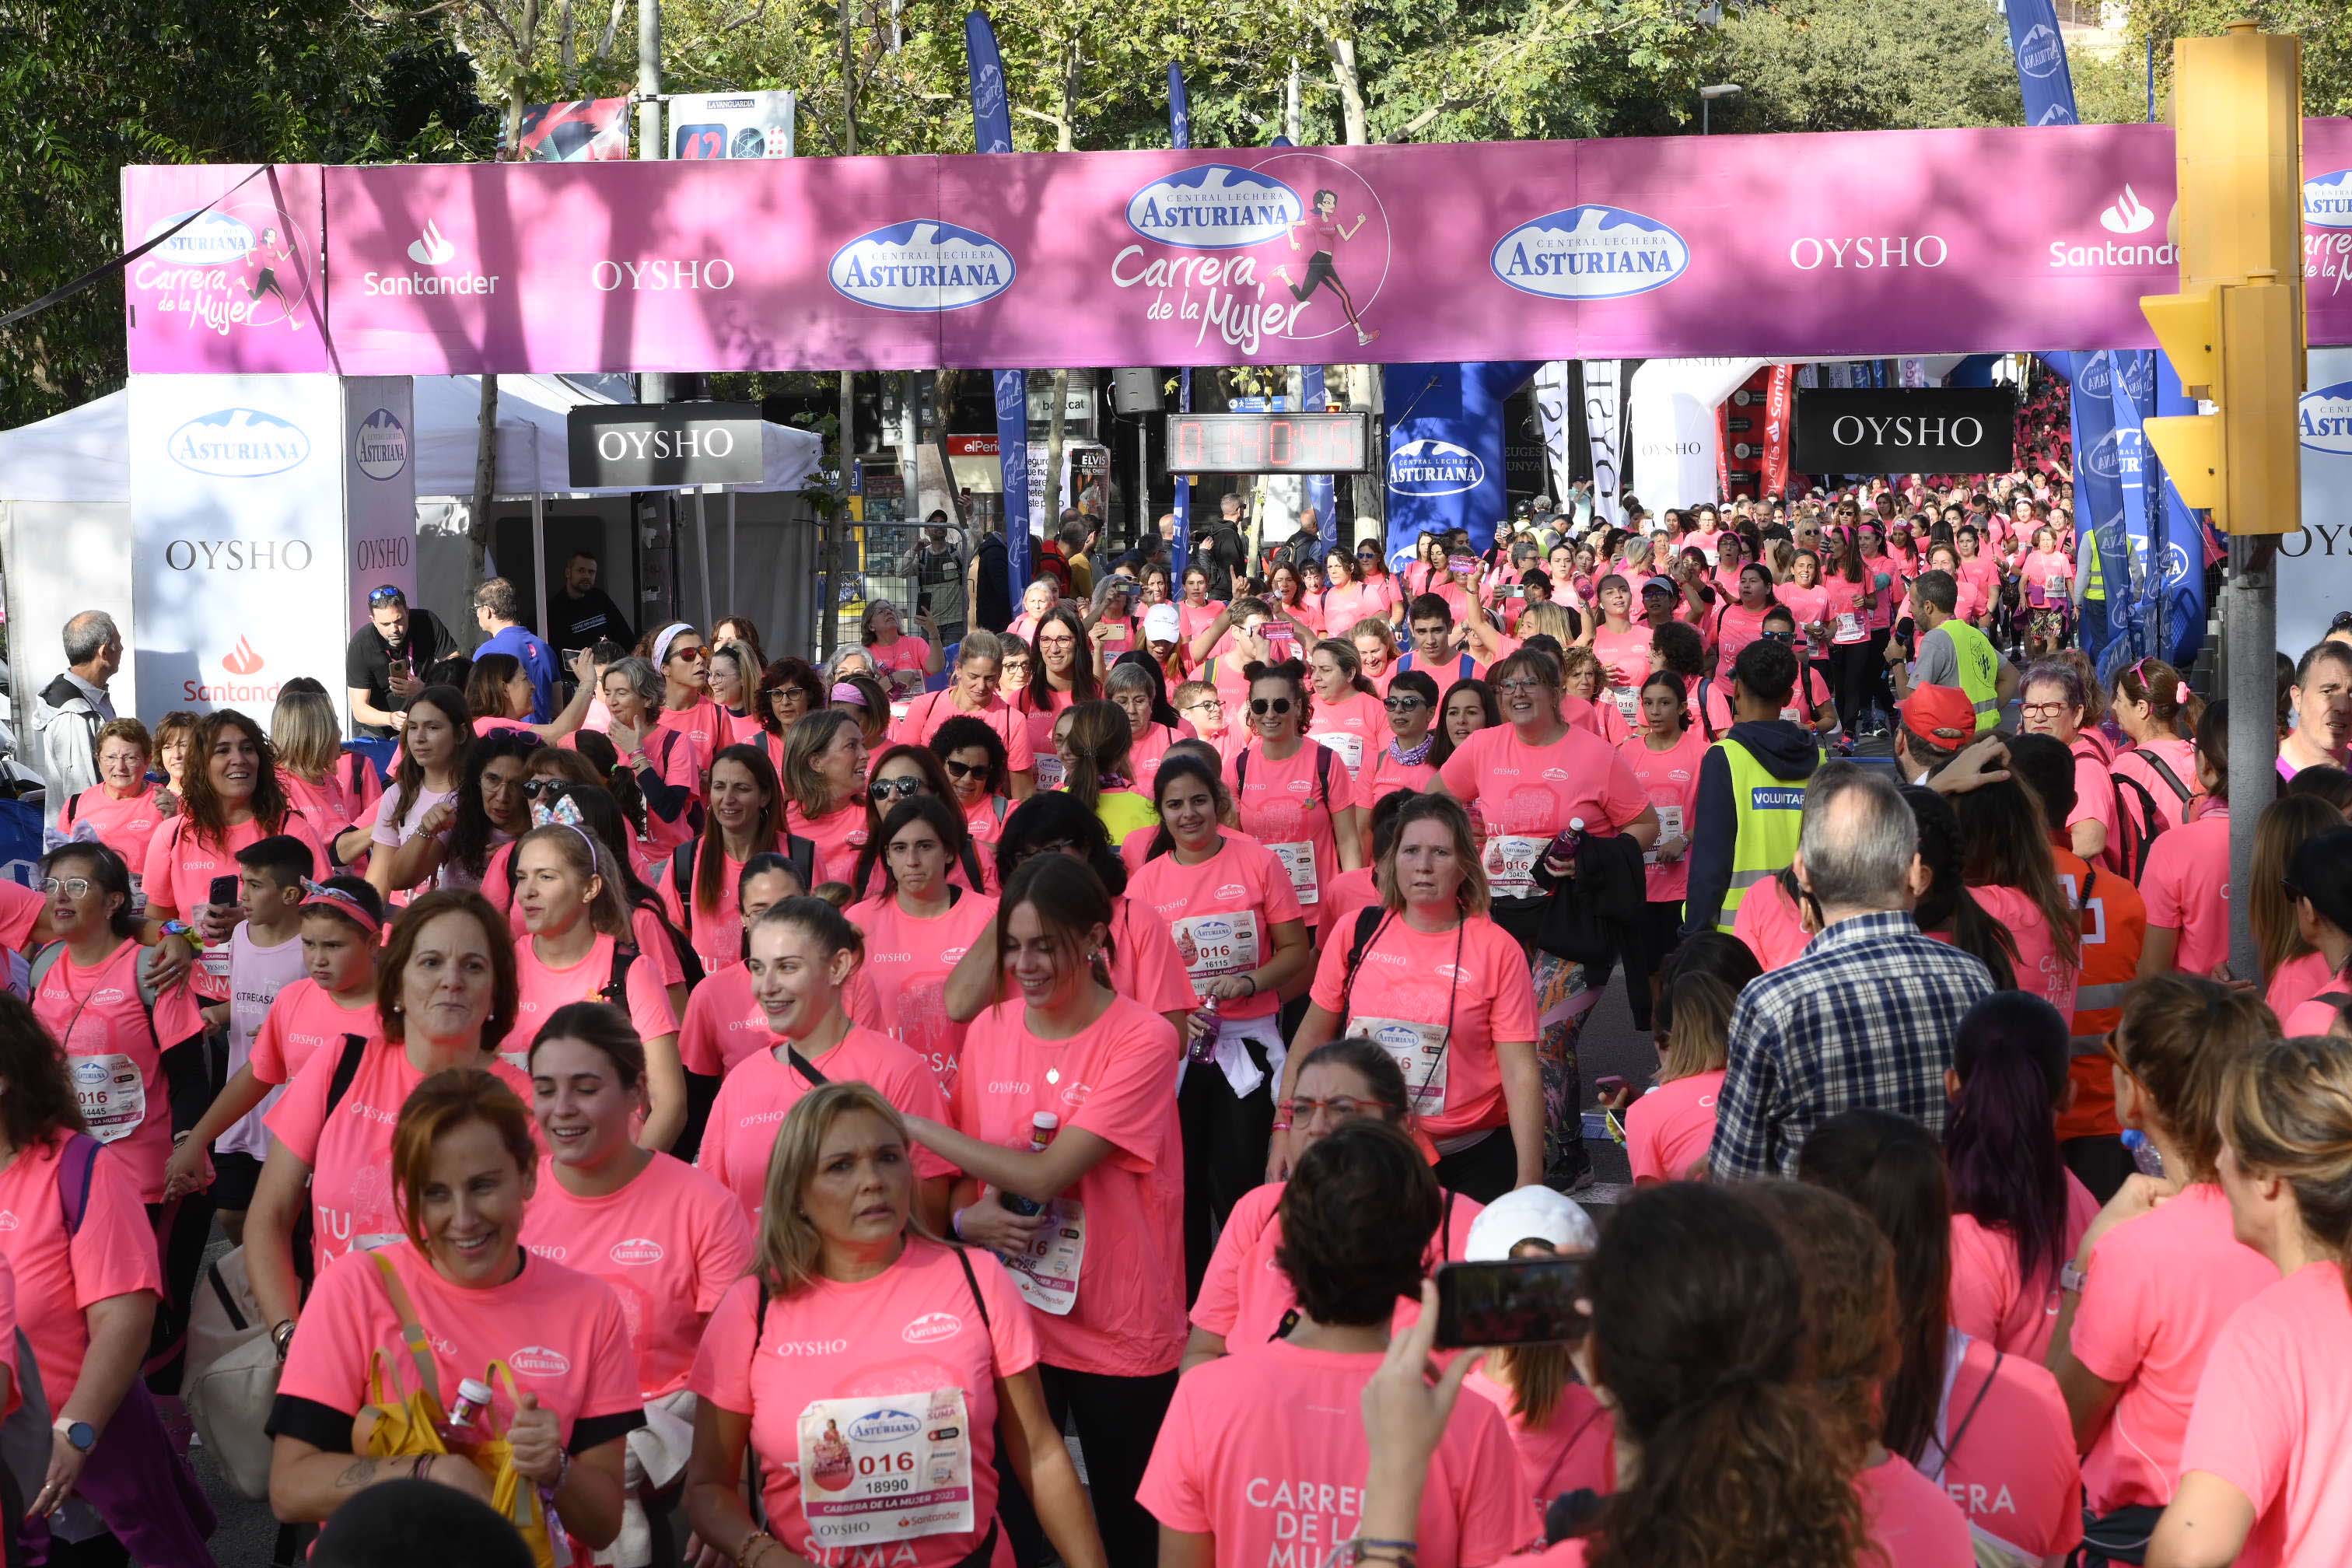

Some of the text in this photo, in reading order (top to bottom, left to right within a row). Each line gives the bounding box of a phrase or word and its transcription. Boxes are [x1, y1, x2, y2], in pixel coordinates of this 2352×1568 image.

[1167, 191, 1284, 202] CENTRAL LECHERA
[1139, 197, 1290, 227] ASTURIANA
[1537, 236, 1668, 248] CENTRAL LECHERA
[872, 250, 995, 261] CENTRAL LECHERA
[1507, 241, 1673, 277] ASTURIANA
[1790, 235, 1948, 270] OYSHO
[843, 256, 1001, 288] ASTURIANA
[1111, 244, 1257, 287] Carrera
[2322, 257, 2336, 278] la
[135, 261, 226, 290] Carrera
[592, 258, 735, 292] OYSHO
[364, 271, 499, 297] Santander
[158, 288, 261, 336] de la Mujer
[1147, 282, 1311, 355] de la Mujer
[1771, 363, 1786, 419] Santa
[1833, 415, 1983, 447] OYSHO
[180, 435, 299, 460] ASTURIANA
[359, 438, 404, 464] ASTURIANA
[598, 427, 733, 462] OYSHO
[1179, 422, 1353, 465] 01:40:45
[1642, 442, 1701, 456] OYSHO
[1082, 455, 1105, 465] ELVIS
[1389, 462, 1478, 484] ASTURIANA
[1028, 499, 1040, 507] ste
[166, 540, 313, 571] OYSHO
[357, 537, 409, 572] OYSHO
[1040, 774, 1059, 782] 016
[1494, 767, 1520, 775] OYSHO
[1488, 822, 1505, 836] TU
[1505, 845, 1531, 854] ASTURIANA
[182, 860, 215, 872] OYSHO
[1506, 860, 1529, 870] 016
[1197, 929, 1230, 937] ASTURIANA
[874, 952, 911, 963] OYSHO
[1200, 945, 1230, 958] 016
[1367, 950, 1407, 966] OYSHO
[1205, 960, 1228, 968] 16115
[42, 988, 70, 1000] OYSHO
[729, 1016, 769, 1031] OYSHO
[289, 1032, 324, 1048] OYSHO
[1379, 1032, 1416, 1044] ASTURIANA
[988, 1081, 1031, 1096] OYSHO
[78, 1090, 107, 1104] 016
[82, 1108, 107, 1116] 14445
[740, 1111, 785, 1127] OYSHO
[317, 1205, 350, 1240] TU
[612, 1247, 663, 1260] ASTURIANA
[1027, 1240, 1048, 1256] 16
[1031, 1285, 1066, 1306] Santander
[778, 1322, 957, 1357] OYSHO ASTURIANA
[514, 1354, 568, 1372] ASTURIANA
[926, 1409, 956, 1421] SUMA
[854, 1423, 916, 1437] ASTURIANA
[859, 1451, 915, 1475] 016
[866, 1479, 909, 1494] 18990
[823, 1490, 956, 1514] CARRERA DE LA MUJER 2023
[911, 1510, 961, 1527] Santander
[820, 1521, 870, 1537] OYSHO
[1276, 1513, 1318, 1544] DE
